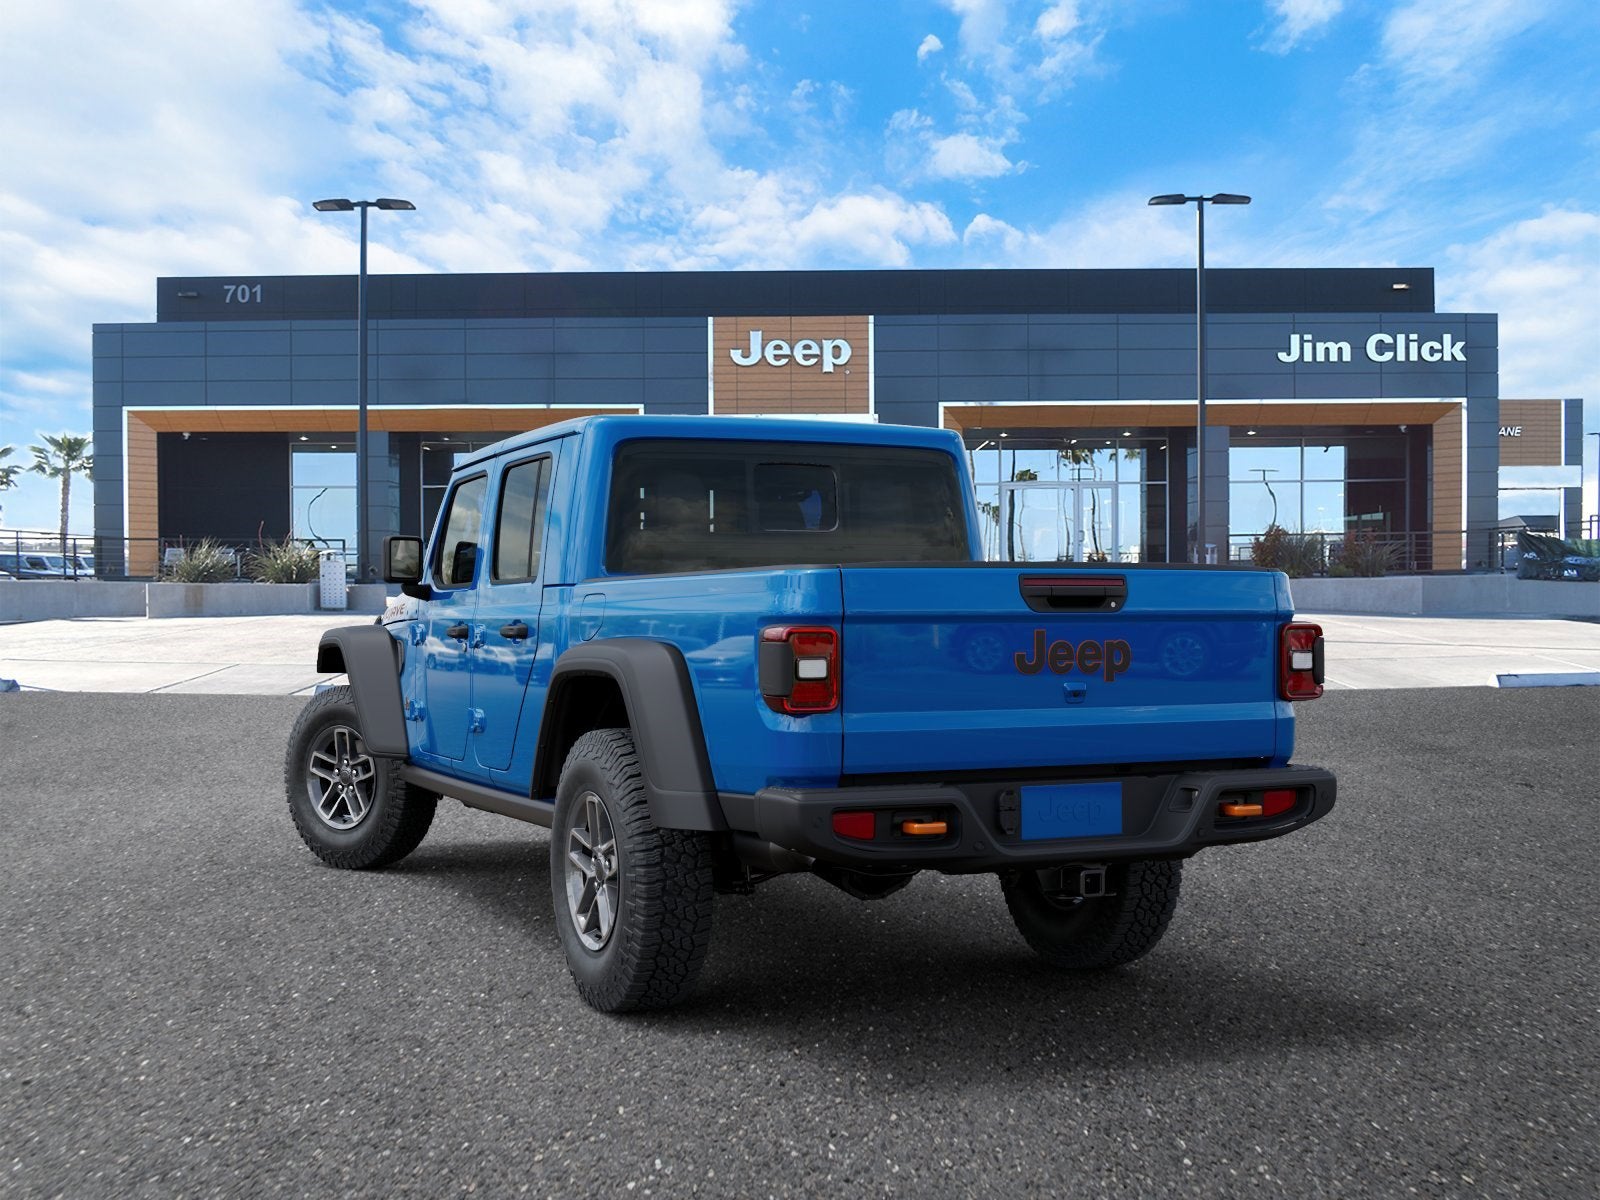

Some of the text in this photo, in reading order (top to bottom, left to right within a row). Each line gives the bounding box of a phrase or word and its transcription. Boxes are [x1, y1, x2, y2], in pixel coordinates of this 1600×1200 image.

[223, 284, 262, 303] 701
[729, 330, 852, 373] Jeep
[1277, 333, 1467, 363] Jim Click
[1014, 628, 1132, 682] Jeep
[1038, 792, 1105, 826] Jeep
